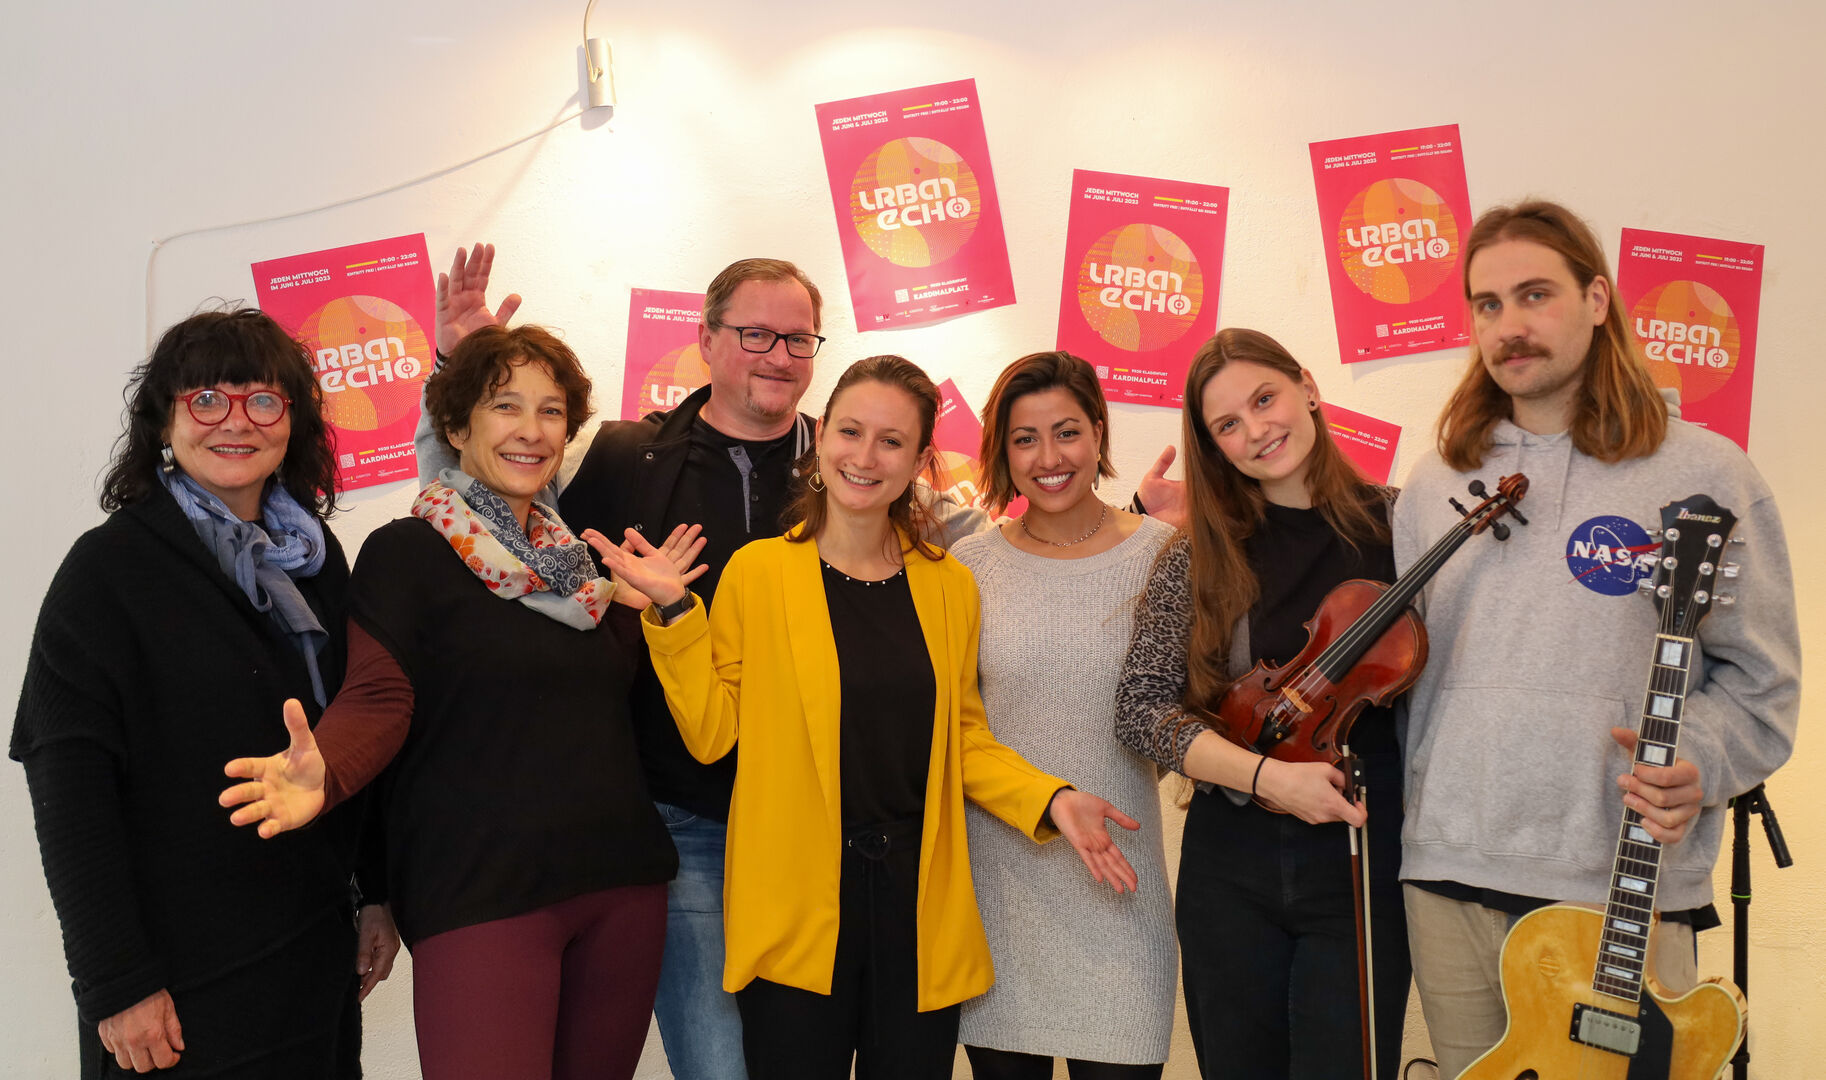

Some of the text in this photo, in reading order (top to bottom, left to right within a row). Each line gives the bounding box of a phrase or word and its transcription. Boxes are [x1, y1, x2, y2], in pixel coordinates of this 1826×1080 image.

[1106, 190, 1139, 198] MITTWOCH
[270, 269, 328, 284] JEDEN MITTWOCH
[1113, 374, 1167, 385] KARDINALPLATZ
[360, 448, 416, 464] KARDINALPLAT
[1677, 507, 1722, 523] Ibanez
[1573, 540, 1649, 572] NASA
